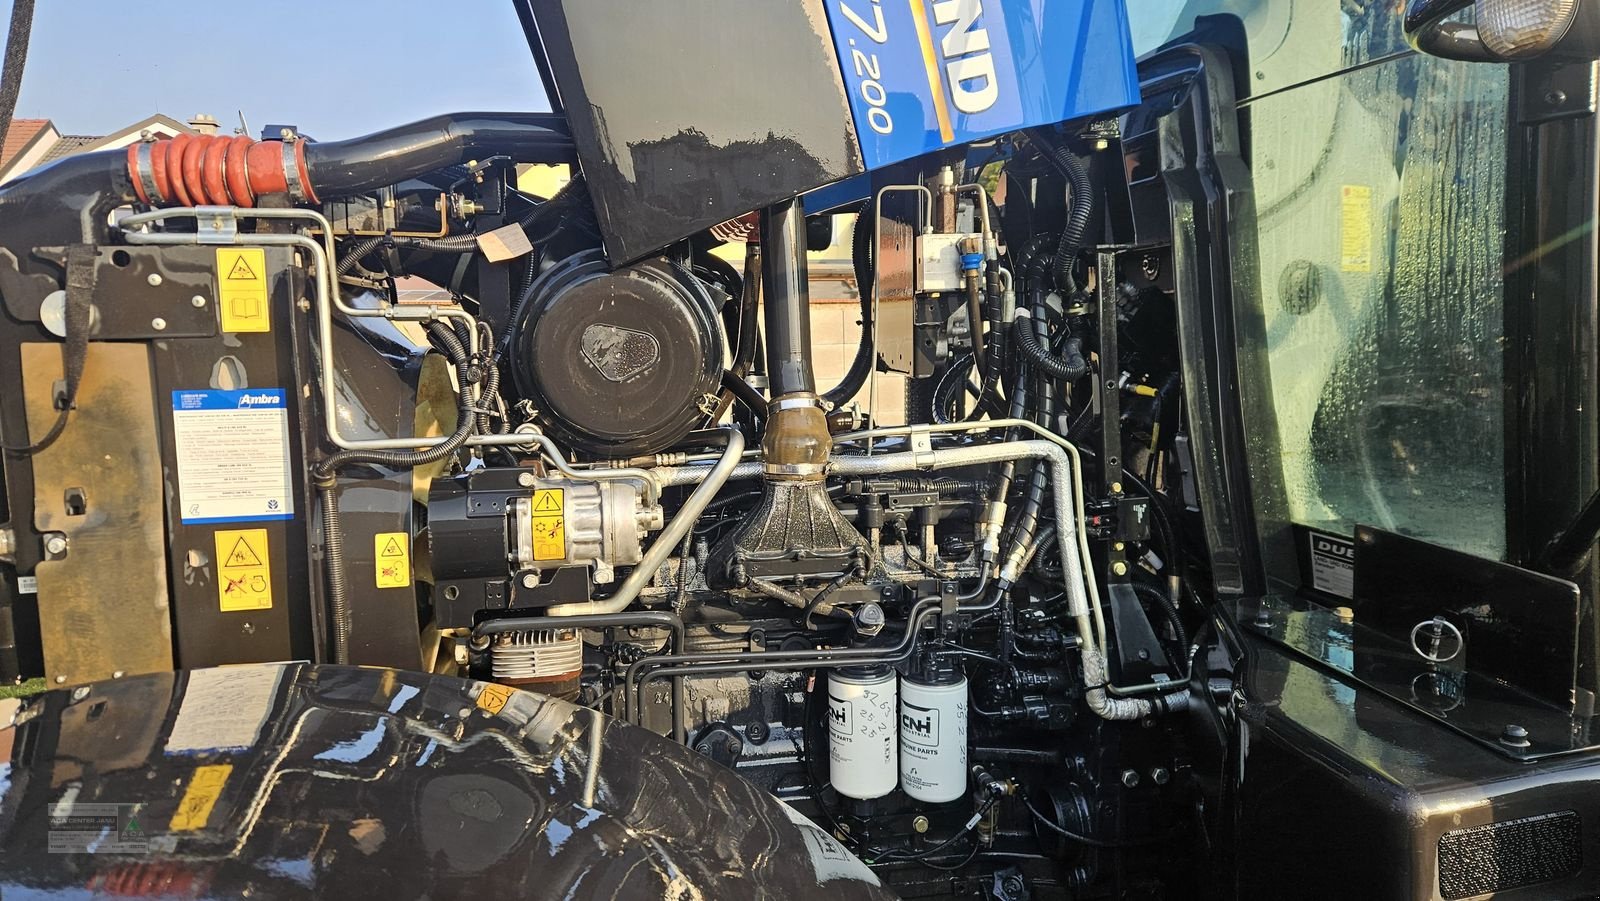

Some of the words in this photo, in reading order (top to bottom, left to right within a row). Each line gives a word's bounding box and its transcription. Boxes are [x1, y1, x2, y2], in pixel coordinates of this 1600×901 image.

[931, 0, 999, 114] ND
[840, 0, 894, 135] 7.200
[240, 393, 280, 405] Ambra
[1318, 540, 1354, 558] DUE
[917, 747, 939, 756] PARTS
